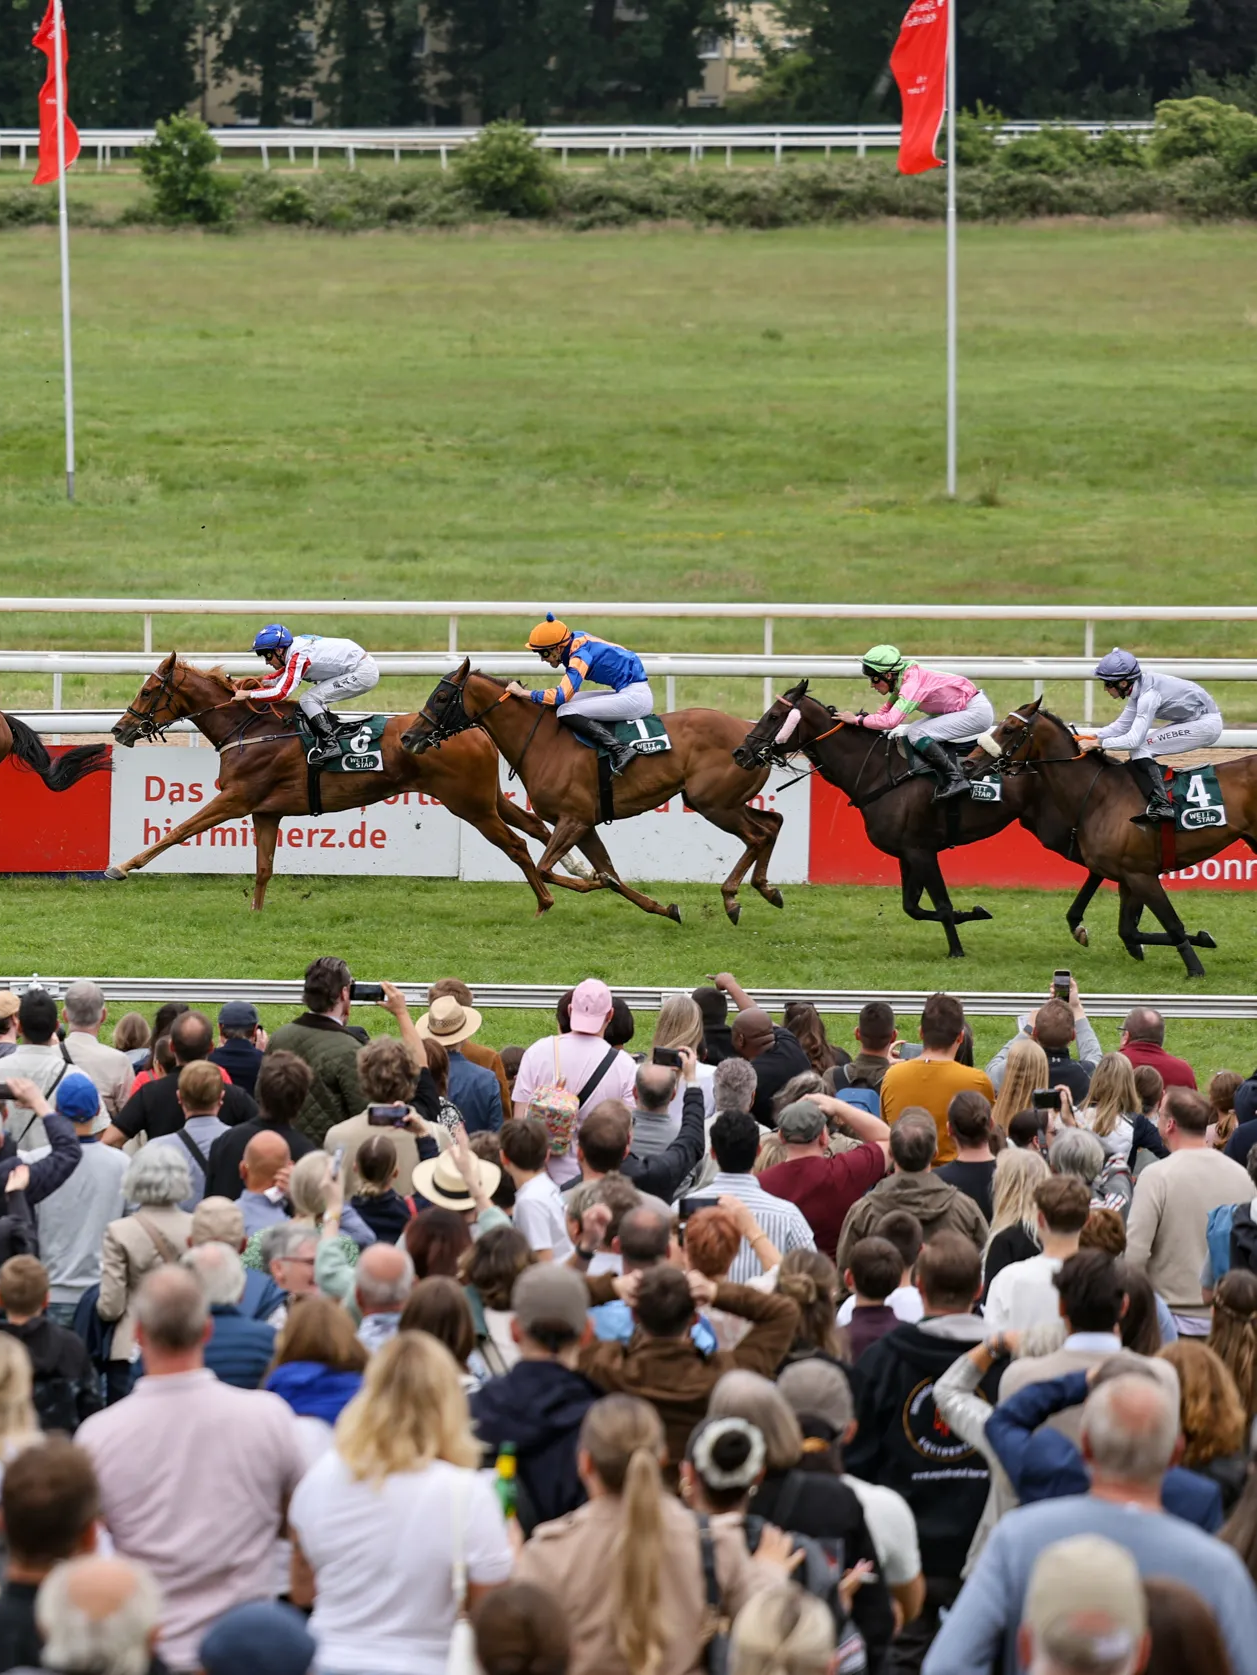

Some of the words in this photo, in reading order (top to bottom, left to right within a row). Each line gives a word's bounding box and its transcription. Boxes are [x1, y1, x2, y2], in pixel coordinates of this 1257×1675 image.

[626, 719, 650, 739] 1
[1157, 729, 1192, 741] WEBER
[350, 726, 373, 753] 6
[635, 741, 657, 749] WETT
[145, 775, 204, 803] Das
[1186, 774, 1212, 807] 4
[1189, 811, 1211, 819] WETT
[1196, 815, 1216, 823] STAR
[143, 818, 387, 849] hirmiterz.de
